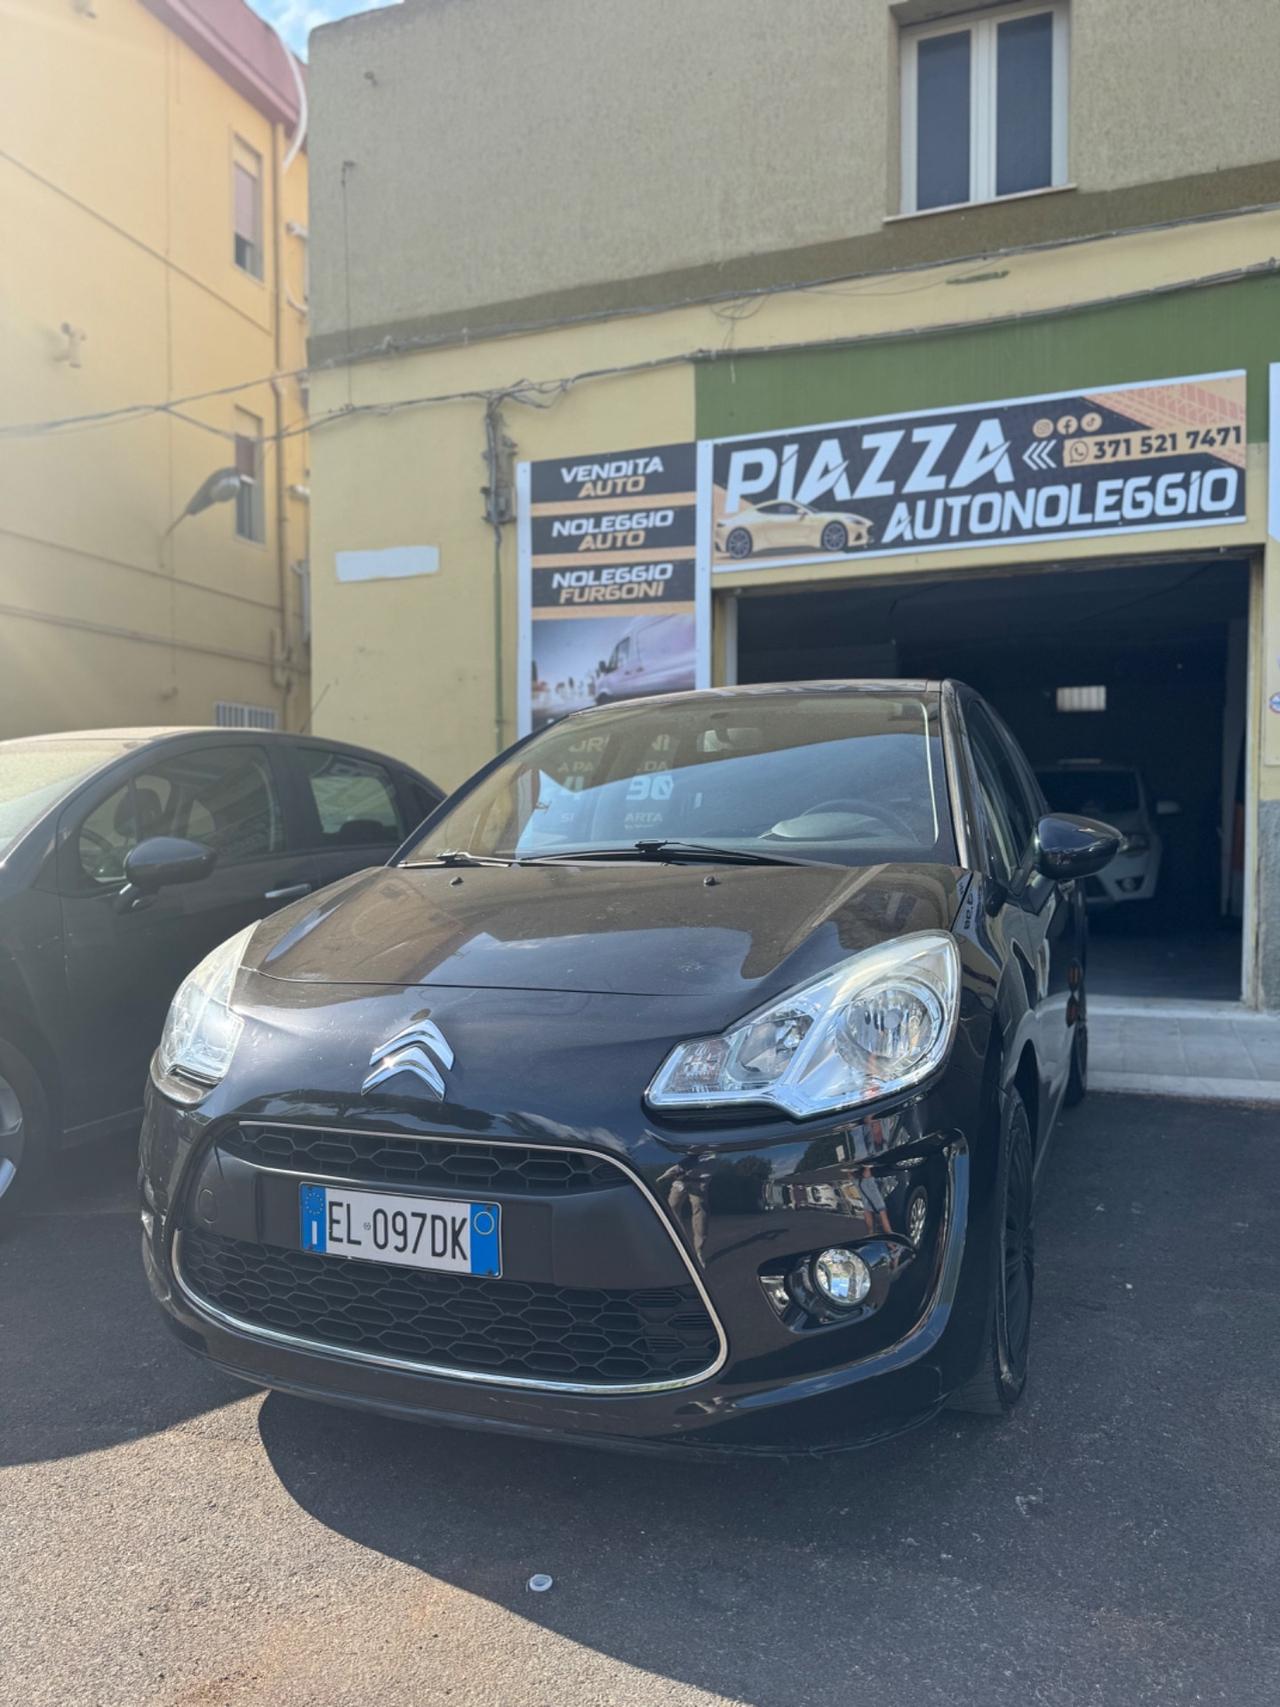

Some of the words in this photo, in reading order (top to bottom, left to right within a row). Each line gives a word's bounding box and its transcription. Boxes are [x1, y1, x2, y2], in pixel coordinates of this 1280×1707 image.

[1093, 438, 1132, 460] 371
[1140, 433, 1177, 455] 521
[1186, 425, 1241, 449] 7471
[560, 456, 664, 483] VENDITA
[724, 418, 1015, 515] PIAZZA
[578, 476, 646, 498] AUTO
[881, 467, 1238, 543] AUTONOLEGGIO
[552, 509, 675, 537] NOLEGGIO
[578, 530, 646, 551] AUTO
[552, 563, 673, 588] NOLEGGIO
[559, 581, 664, 604] FURGONI
